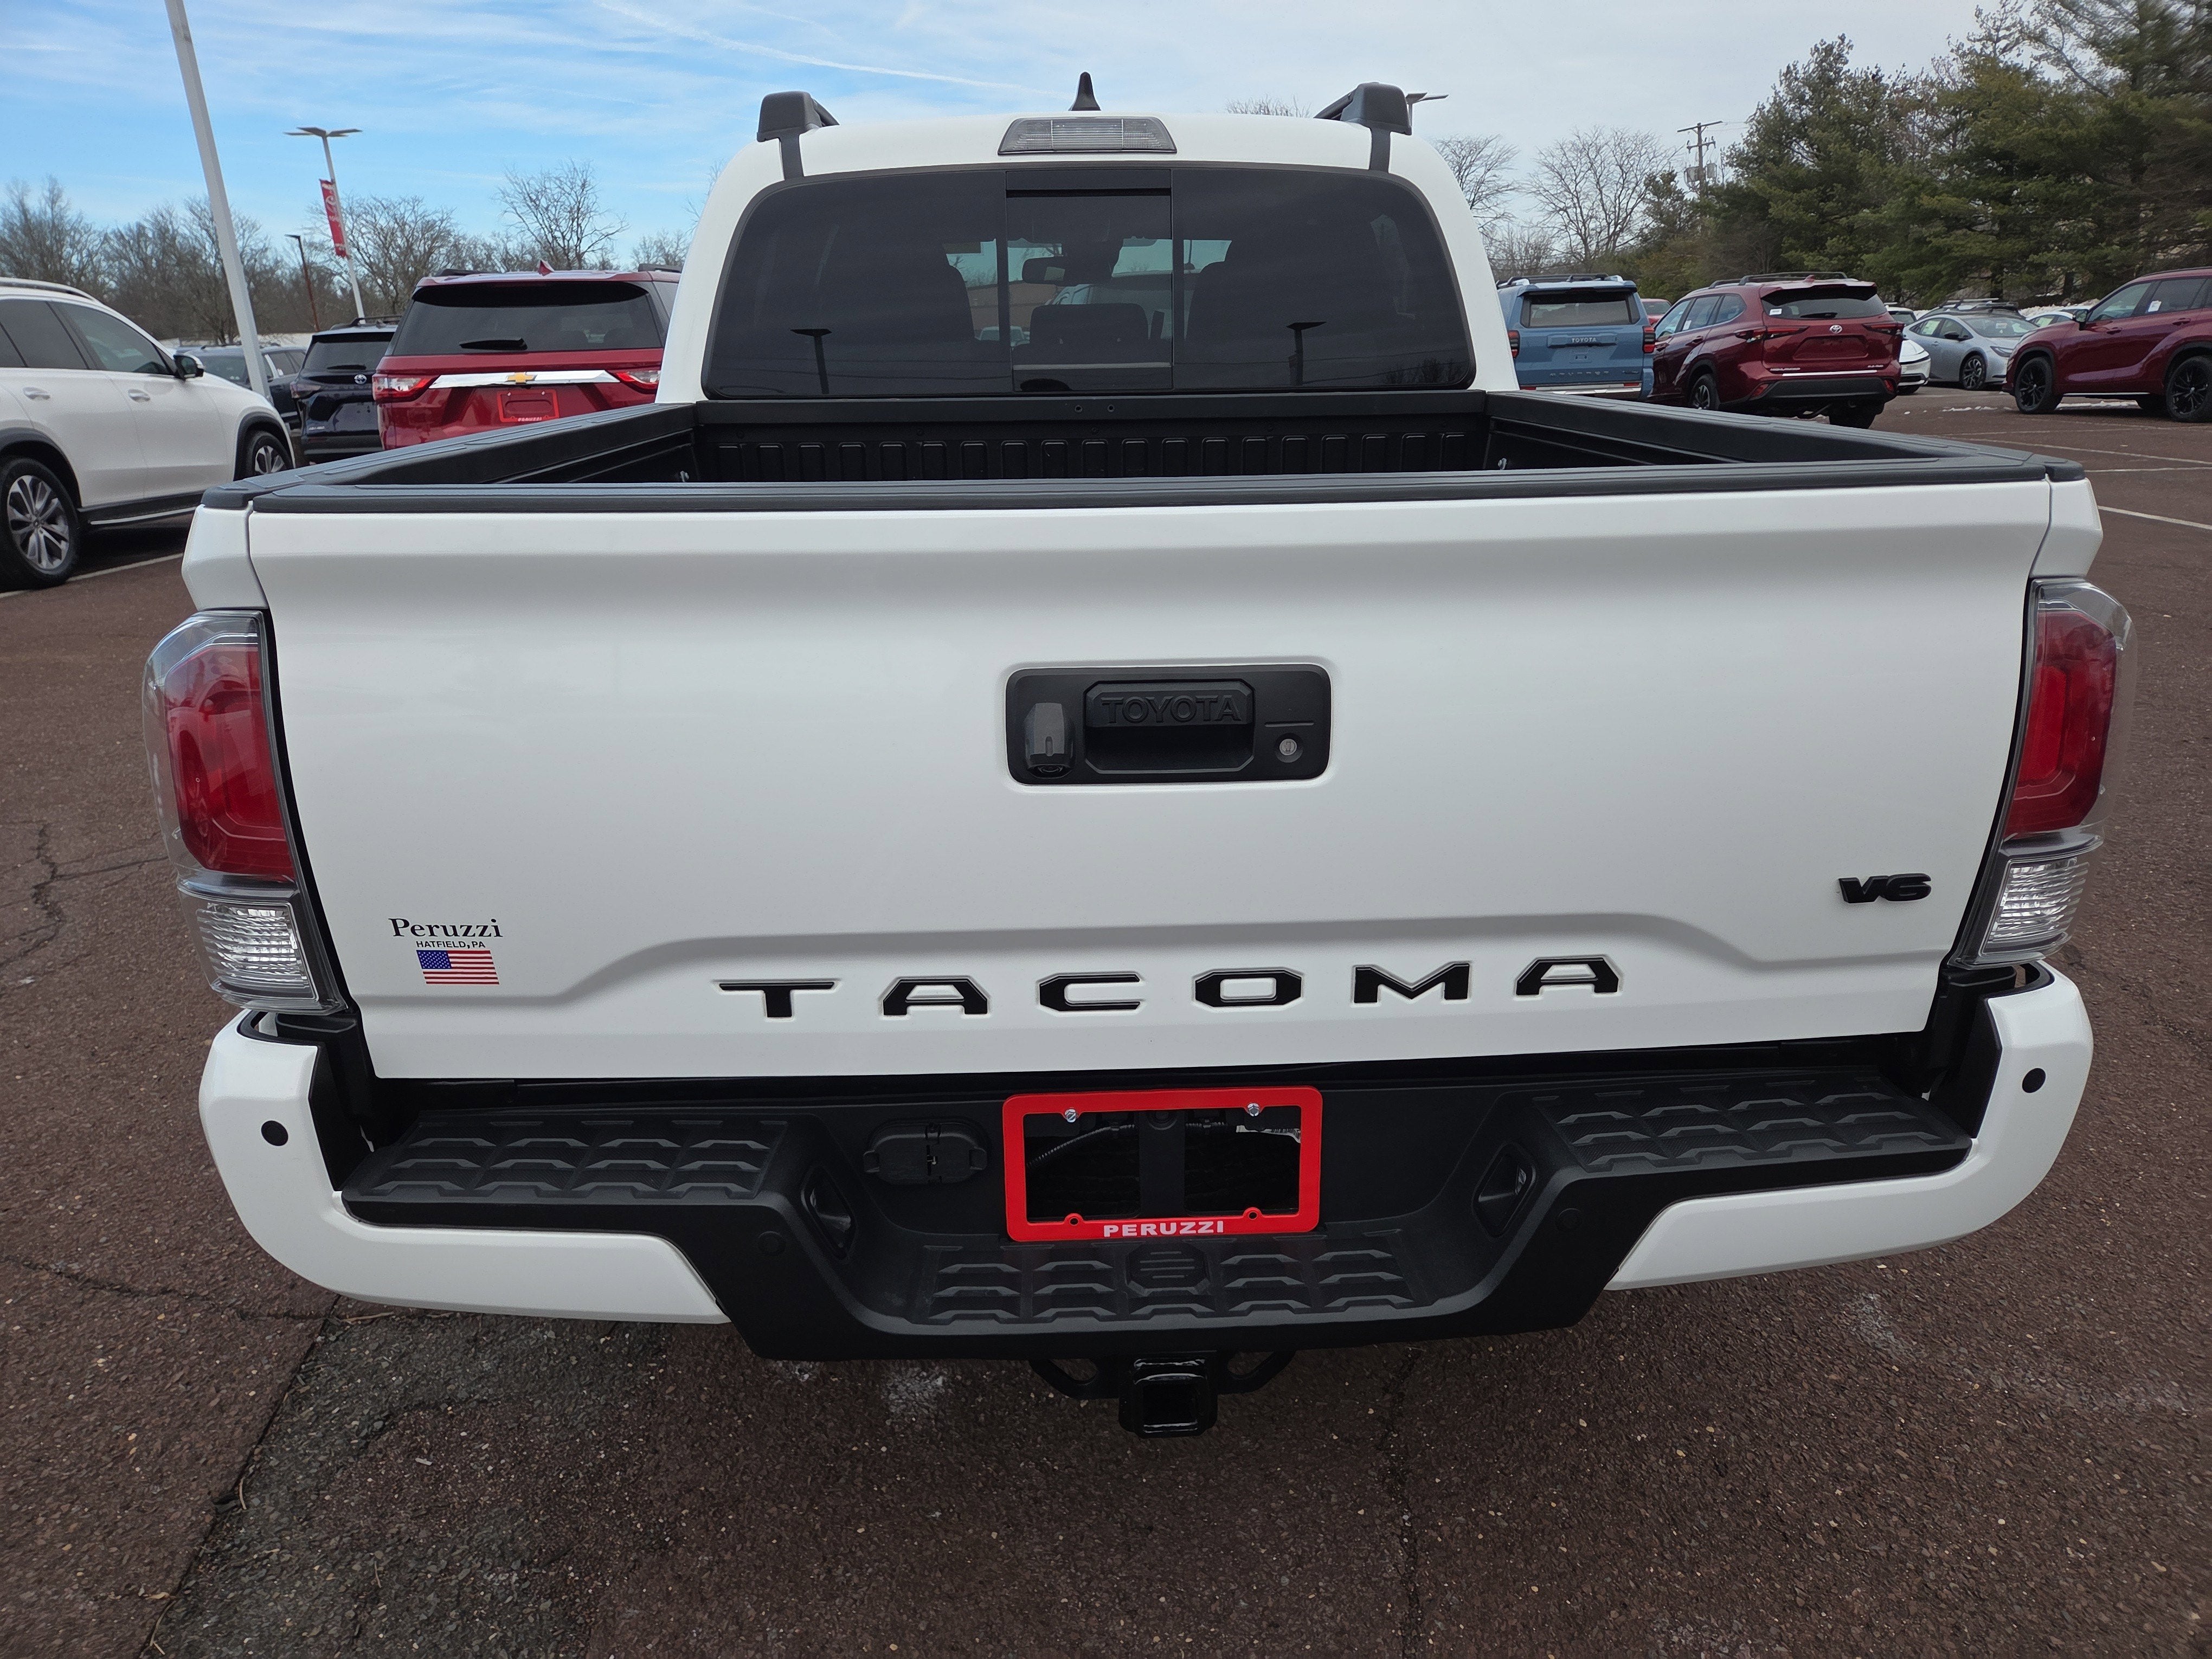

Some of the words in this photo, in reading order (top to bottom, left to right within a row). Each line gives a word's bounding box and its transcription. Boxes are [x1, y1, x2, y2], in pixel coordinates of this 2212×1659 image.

[1100, 695, 1242, 724] TOYOTA
[1838, 873, 1932, 904] V6
[388, 918, 503, 937] Peruzzi
[718, 954, 1621, 1019] TACOMA
[1103, 1220, 1224, 1238] PERUZZI
